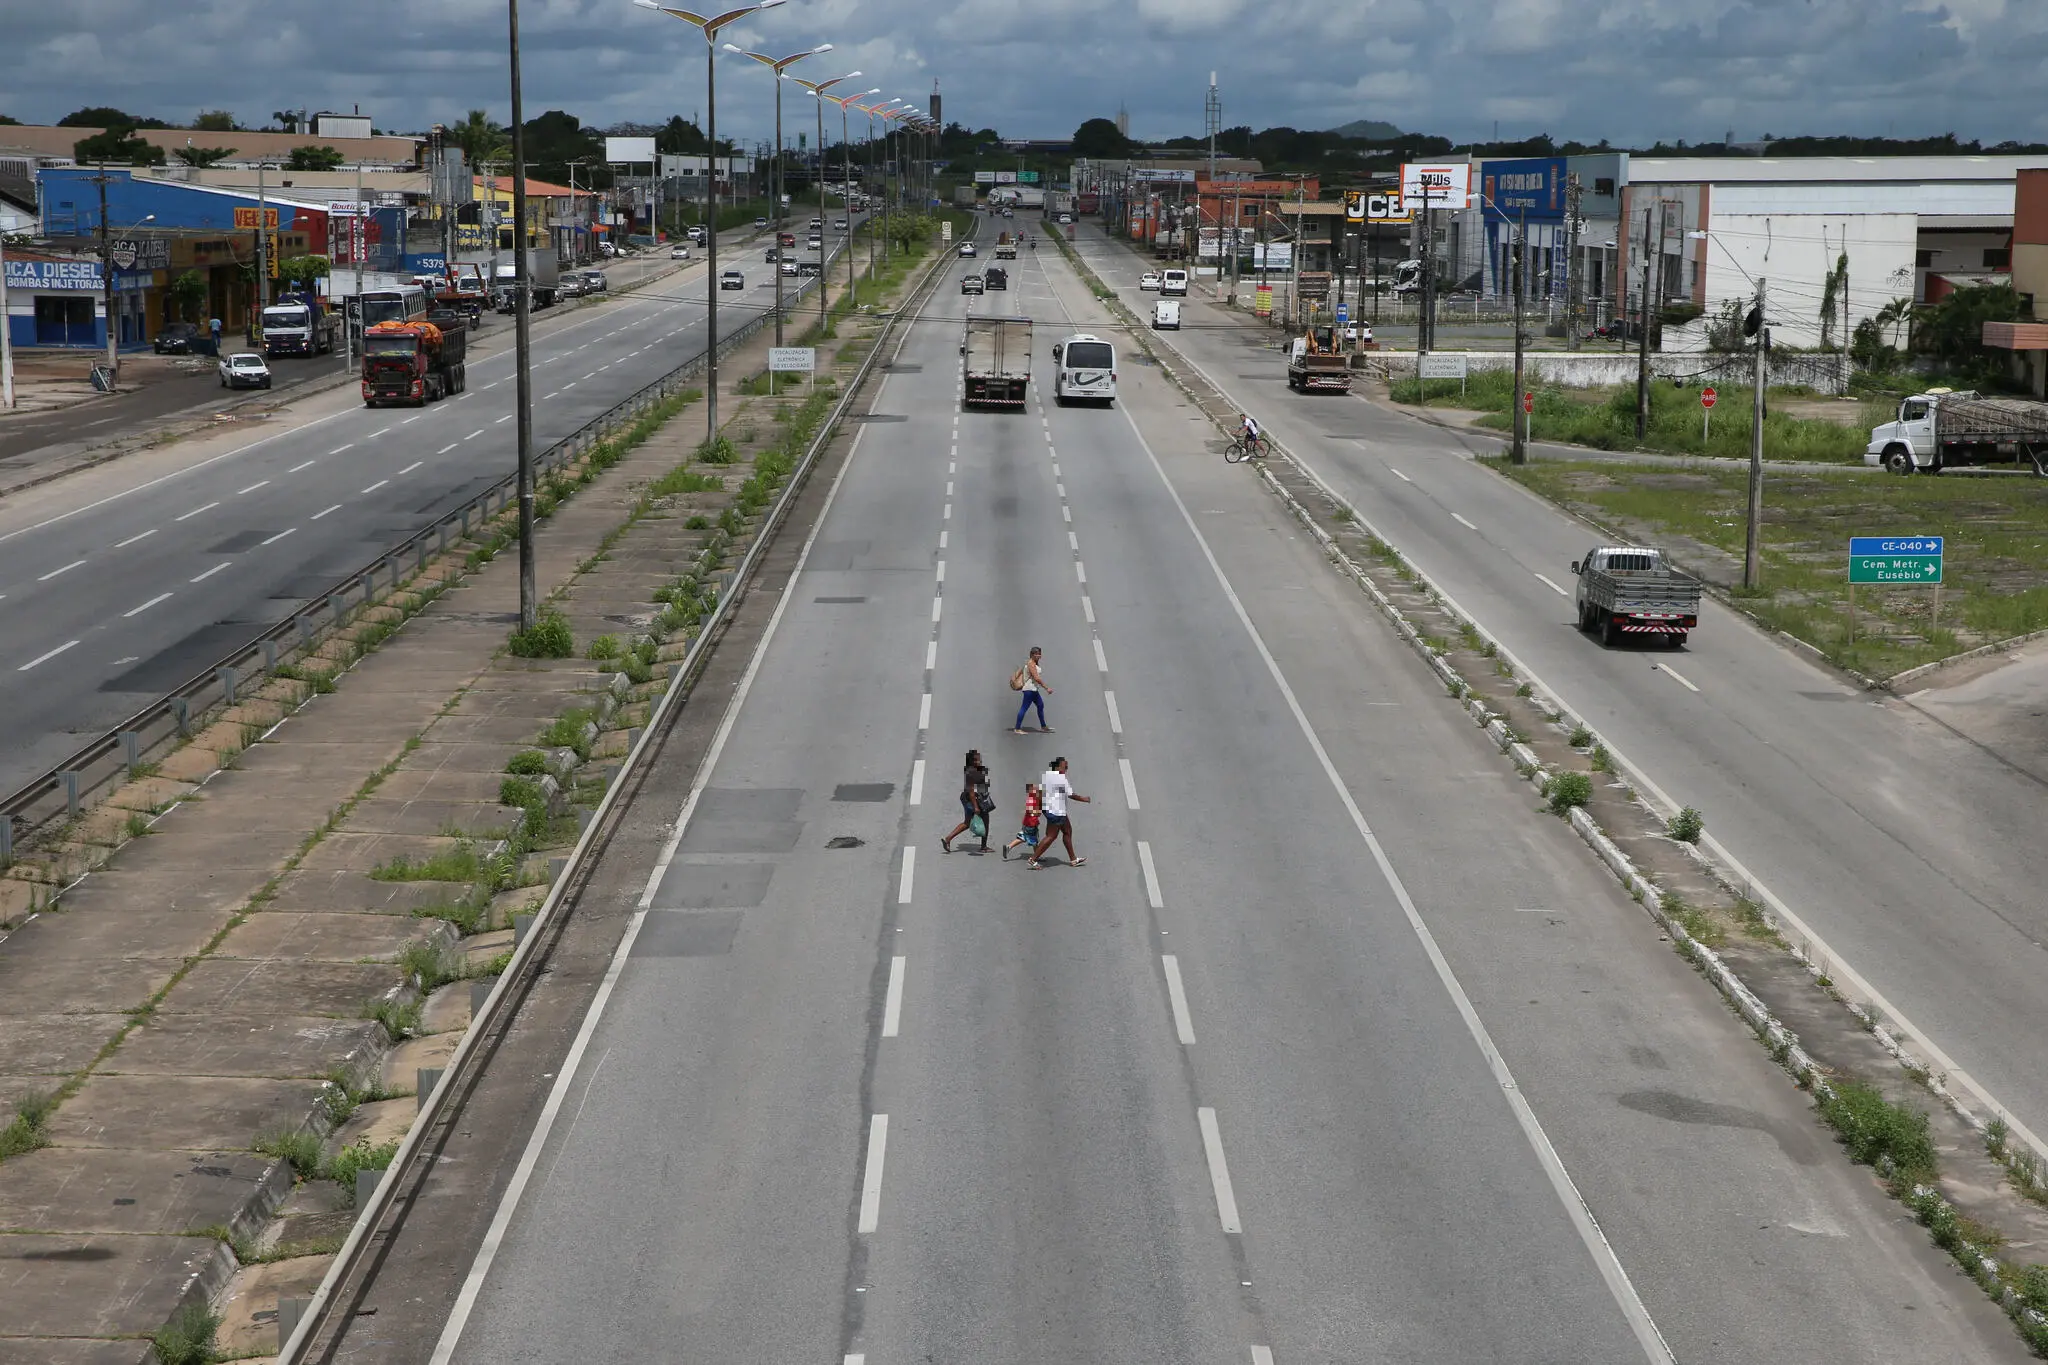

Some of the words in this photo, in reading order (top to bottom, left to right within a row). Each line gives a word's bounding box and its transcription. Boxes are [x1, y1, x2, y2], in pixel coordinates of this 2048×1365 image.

[1421, 174, 1450, 186] Mills
[1348, 195, 1410, 218] JCB
[423, 259, 445, 269] 5379
[43, 263, 102, 279] DIESEL
[7, 277, 50, 288] BOMBAS
[51, 279, 105, 290] INJETORAS
[1881, 542, 1922, 551] CE-040
[1862, 560, 1888, 569] Cem.
[1893, 560, 1921, 569] Metr.
[1877, 569, 1921, 580] Eusébio
